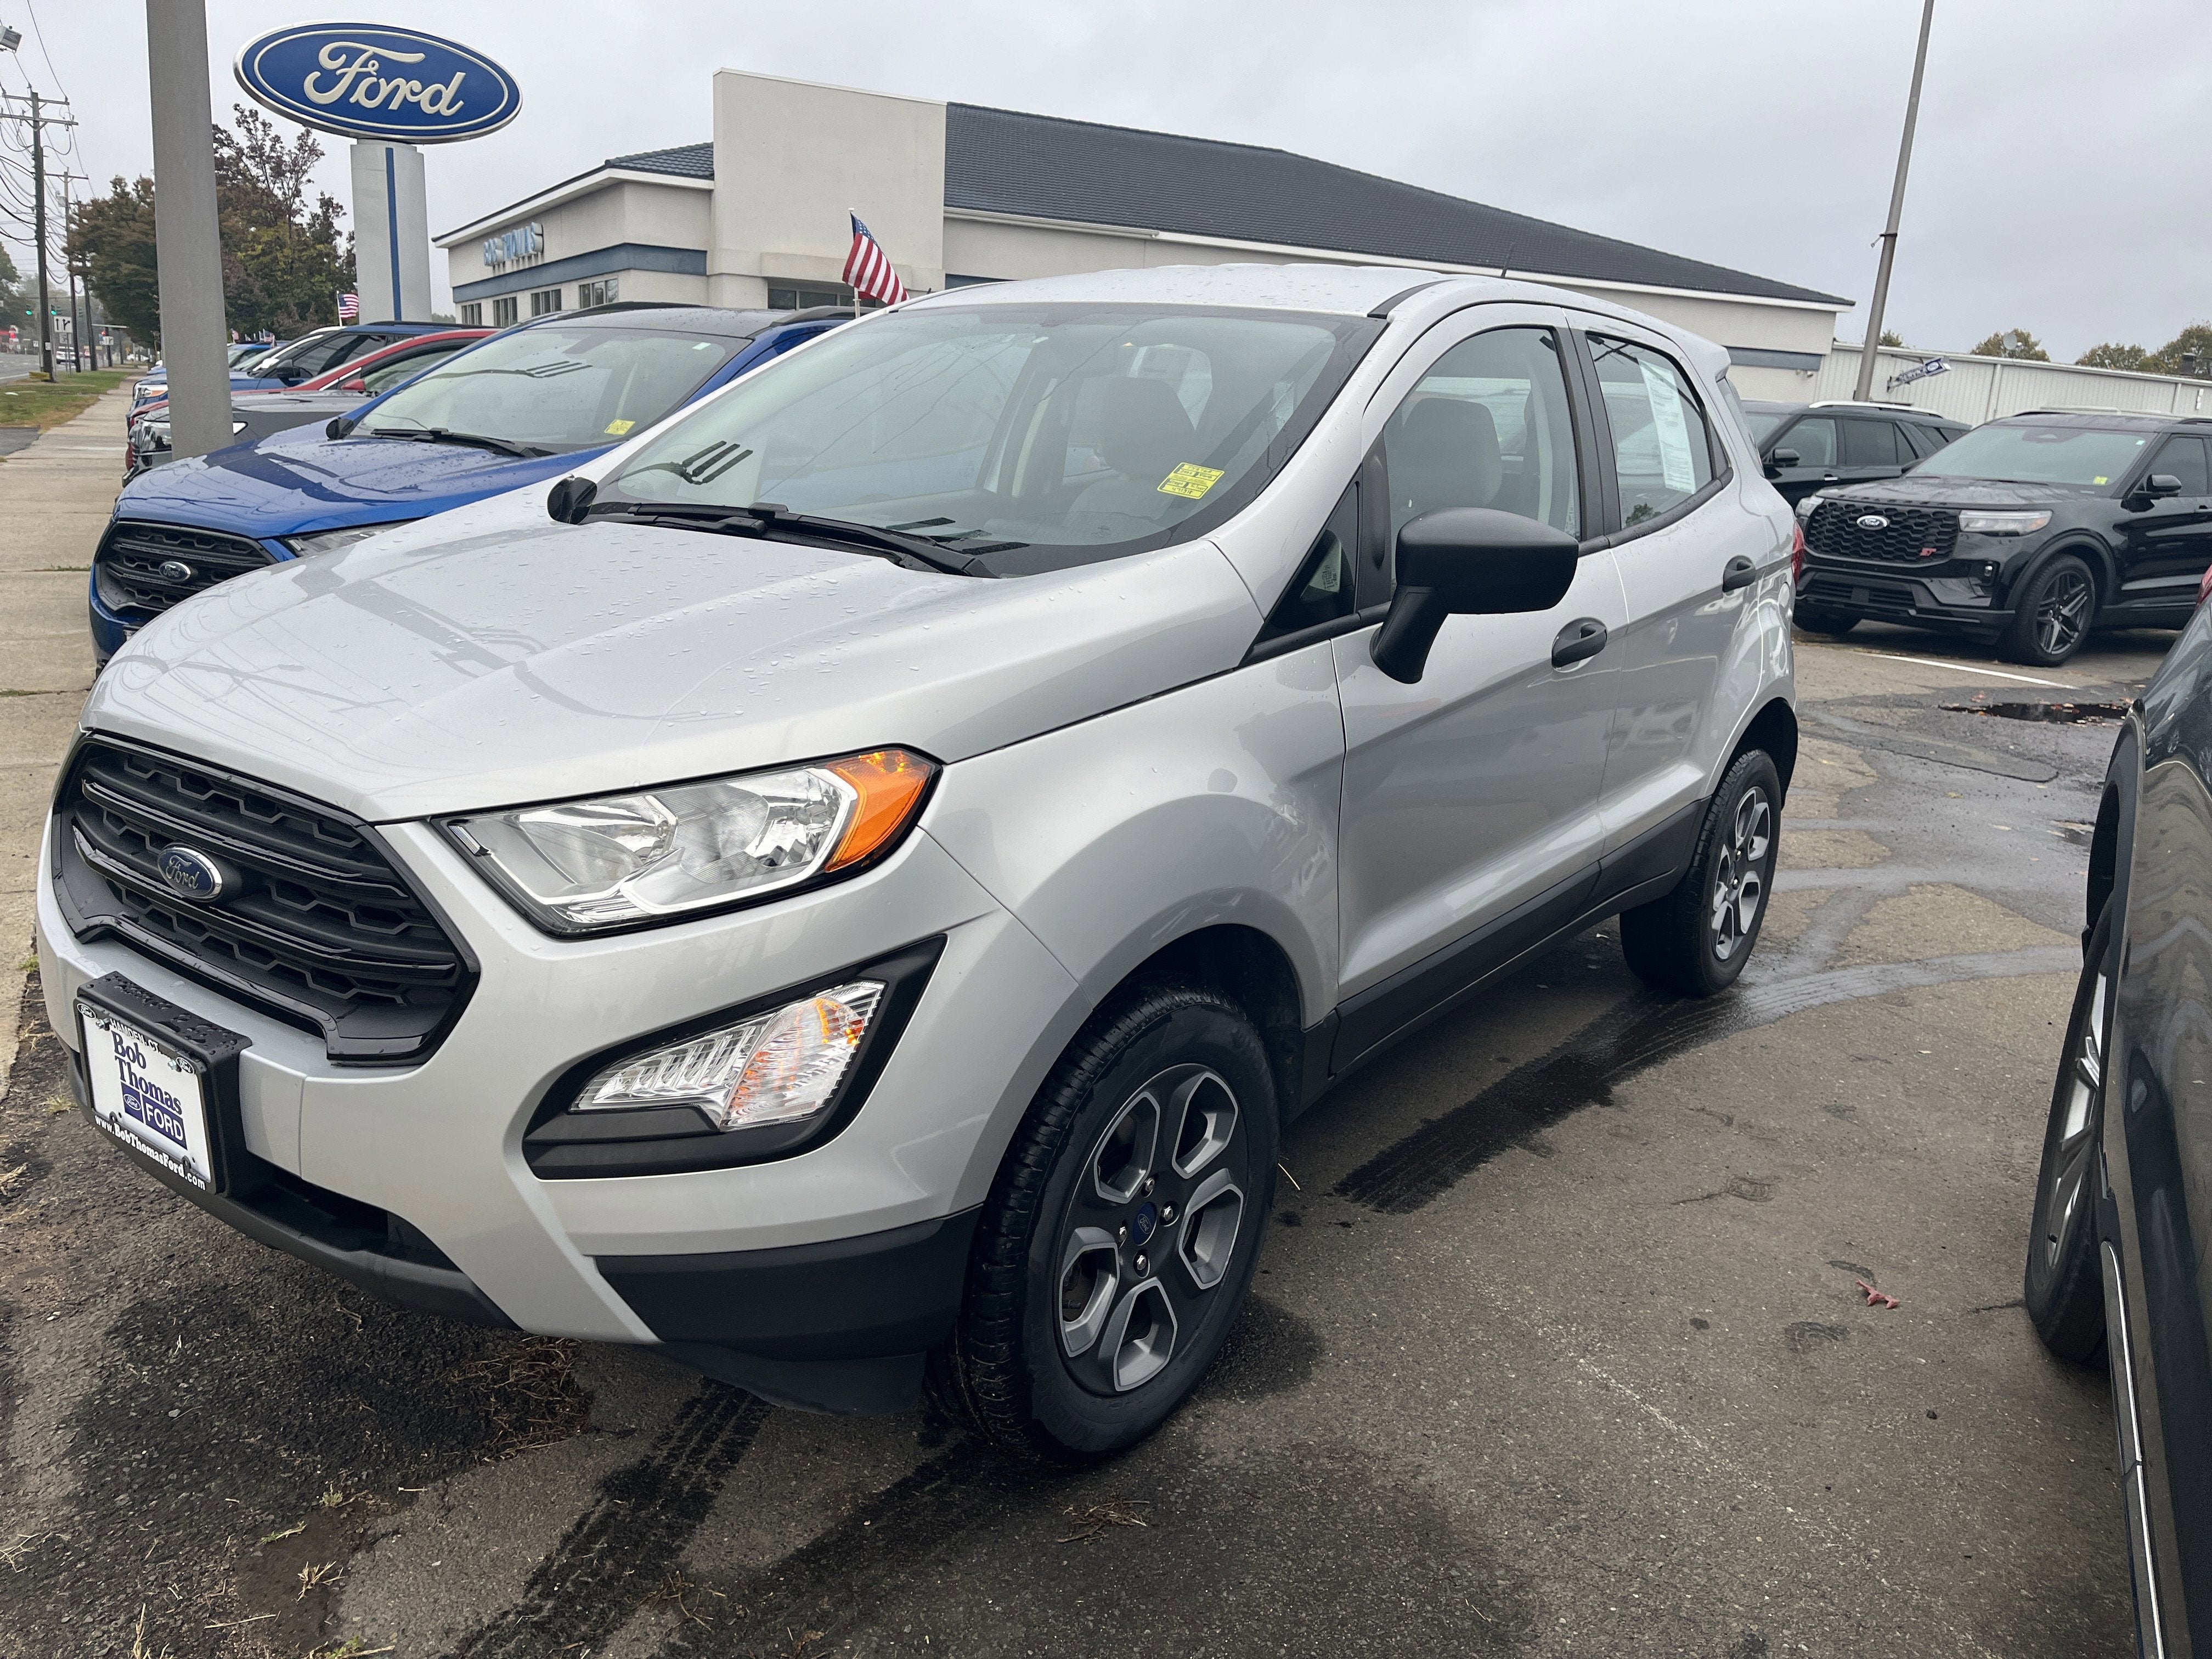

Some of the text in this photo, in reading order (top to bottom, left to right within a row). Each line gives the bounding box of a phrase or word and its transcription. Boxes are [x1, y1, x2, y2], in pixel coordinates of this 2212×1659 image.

[303, 41, 466, 116] Ford
[166, 855, 200, 889] Ford
[111, 1030, 146, 1069] Bob
[115, 1055, 183, 1115] Thomas
[145, 1102, 183, 1141] FORD
[94, 1115, 206, 1191] www.BobThomasFord.com
